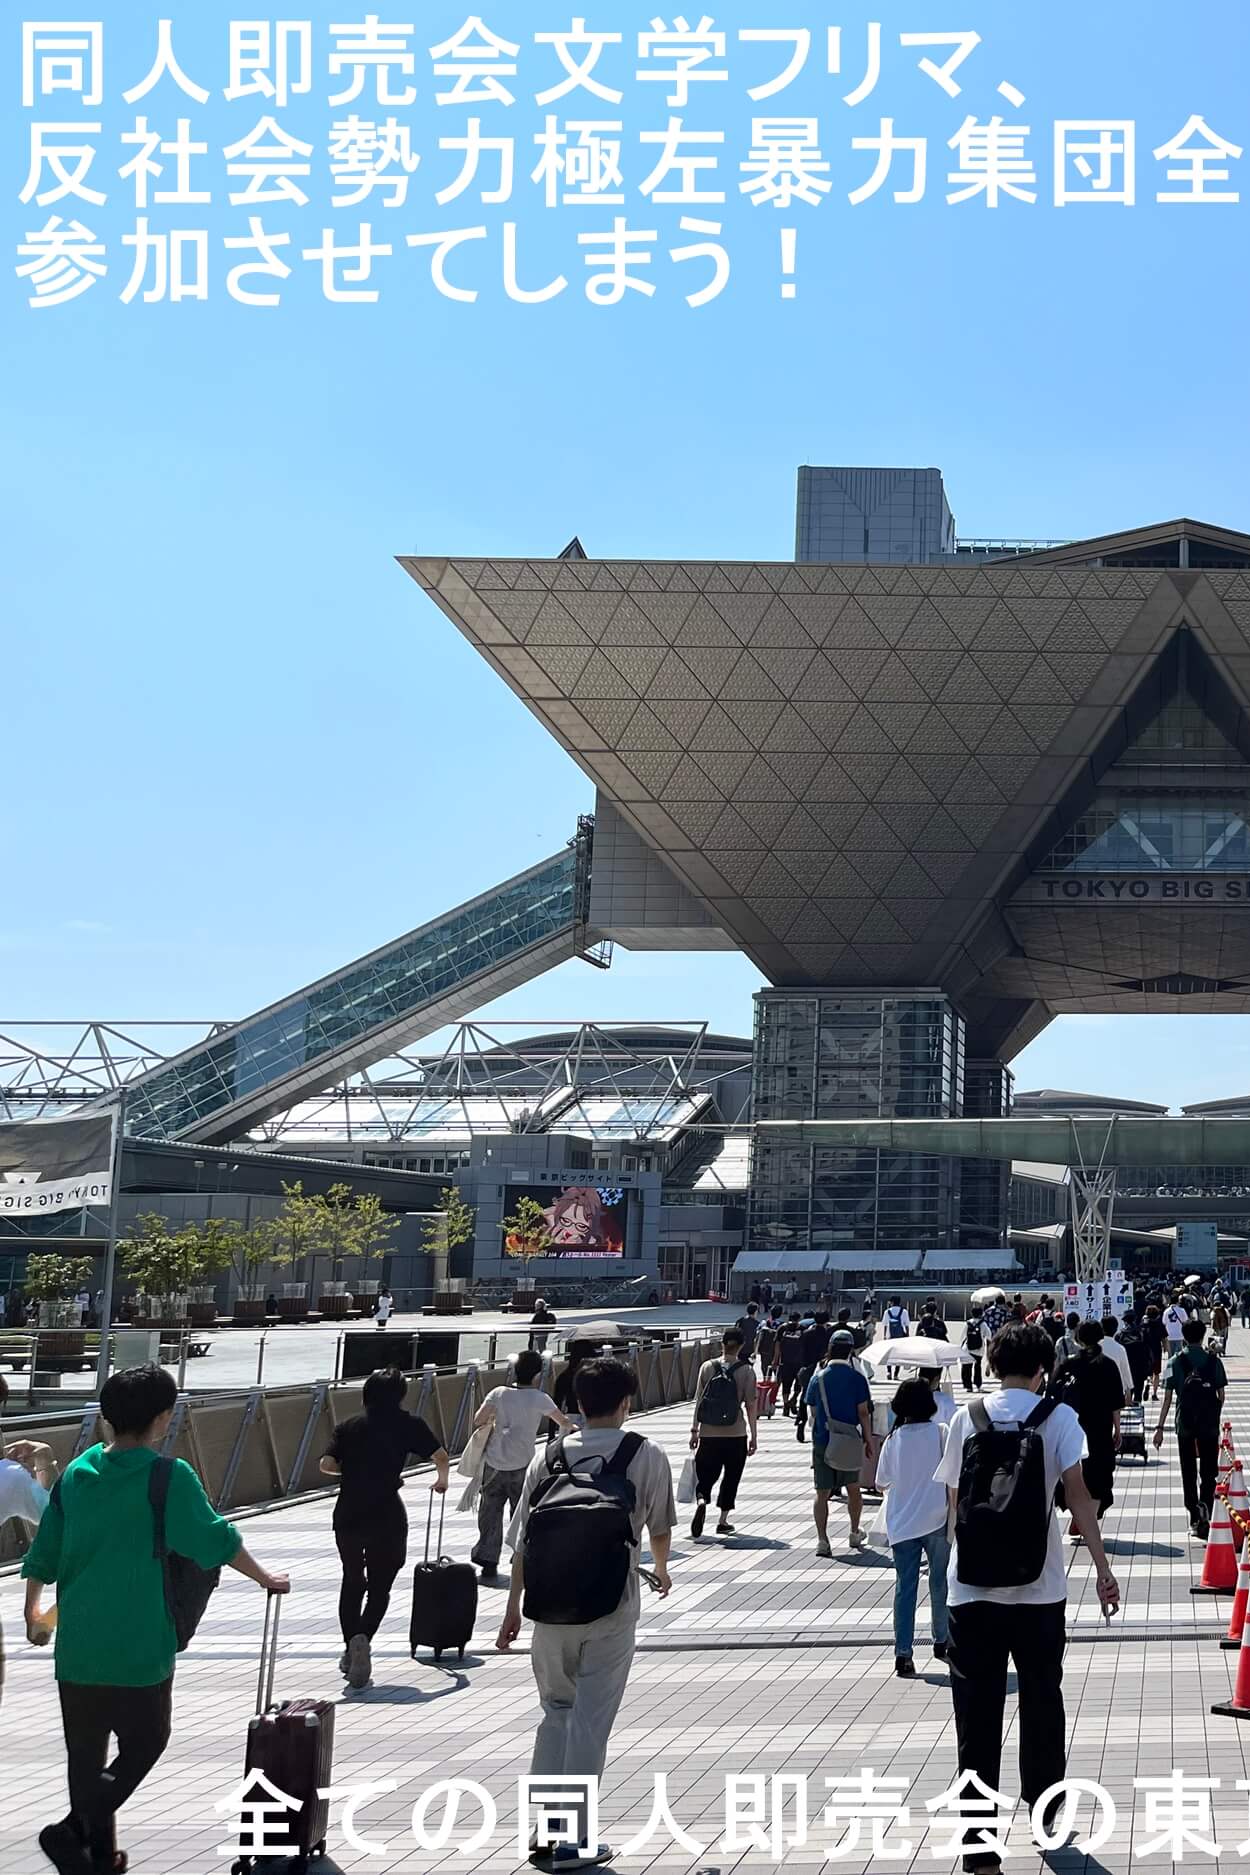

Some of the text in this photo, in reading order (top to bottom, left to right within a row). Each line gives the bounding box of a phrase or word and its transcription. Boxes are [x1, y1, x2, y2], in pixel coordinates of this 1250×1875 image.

[1042, 880, 1149, 898] TOKYO
[1162, 880, 1213, 898] BIG
[540, 1173, 611, 1181] 東京ビッグサイト
